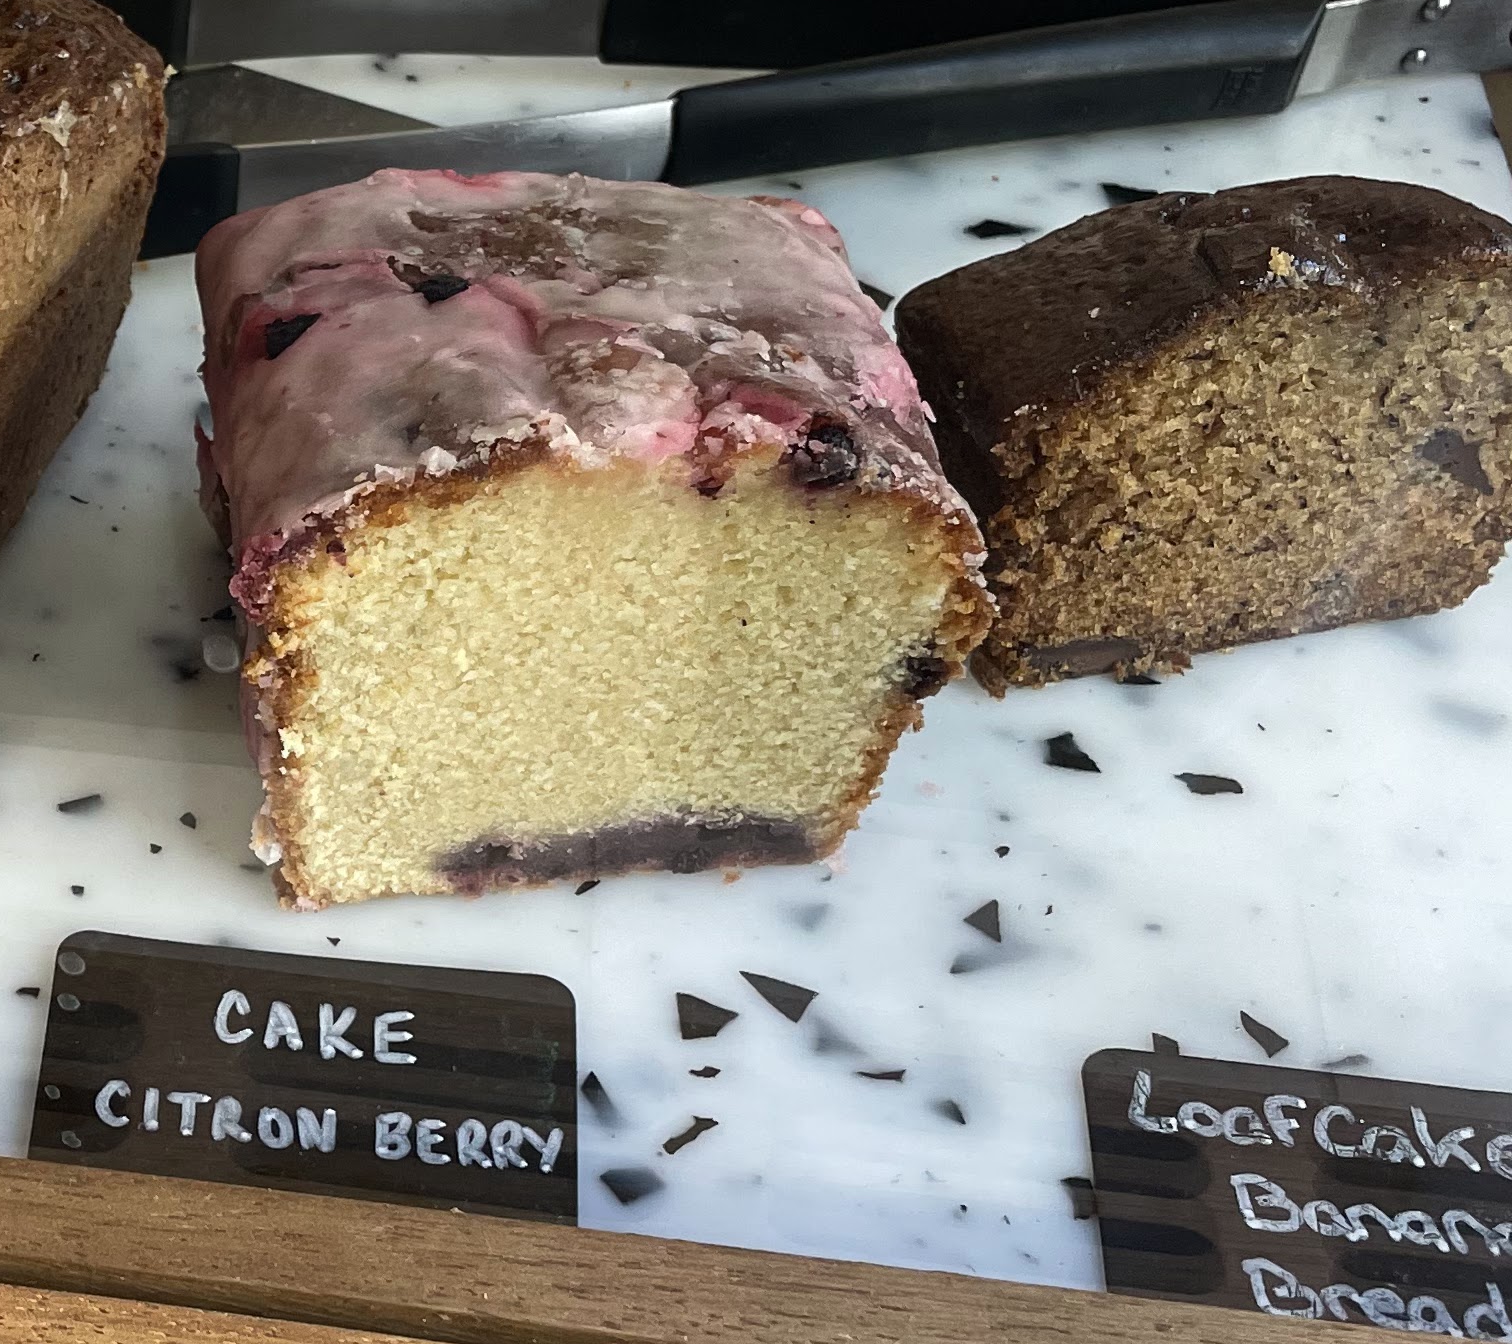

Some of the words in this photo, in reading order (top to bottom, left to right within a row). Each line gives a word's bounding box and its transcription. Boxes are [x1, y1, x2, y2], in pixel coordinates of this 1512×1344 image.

[213, 989, 418, 1065] CAKE
[94, 1079, 338, 1154] CITRON
[374, 1111, 565, 1175] BERRY
[1240, 1257, 1512, 1344] Bread
